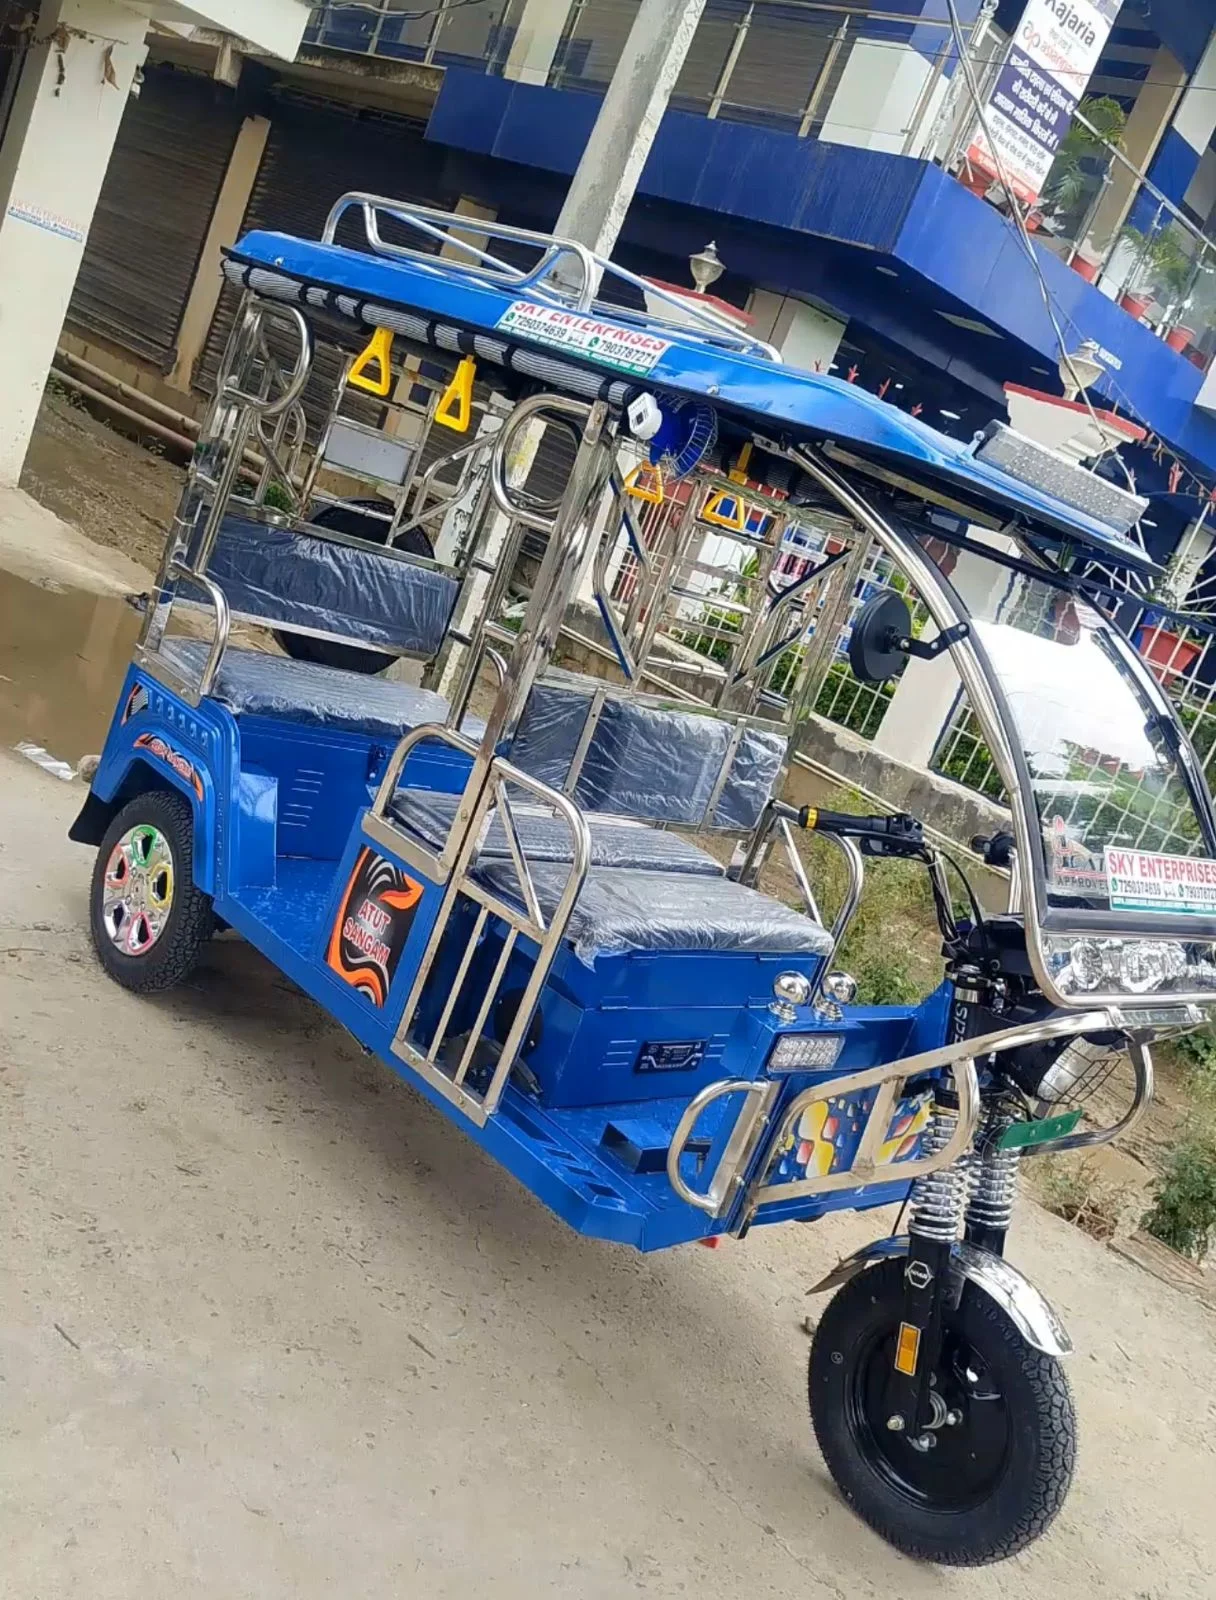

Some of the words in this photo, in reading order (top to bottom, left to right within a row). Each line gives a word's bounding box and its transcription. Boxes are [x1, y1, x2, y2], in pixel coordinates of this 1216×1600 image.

[514, 315, 568, 339] 7250374639
[601, 339, 656, 366] 7903787271
[1109, 852, 1135, 876] SKY
[1139, 856, 1216, 884] ENTERPRISES
[357, 898, 392, 935] ATUT
[342, 916, 392, 967] SANGAM
